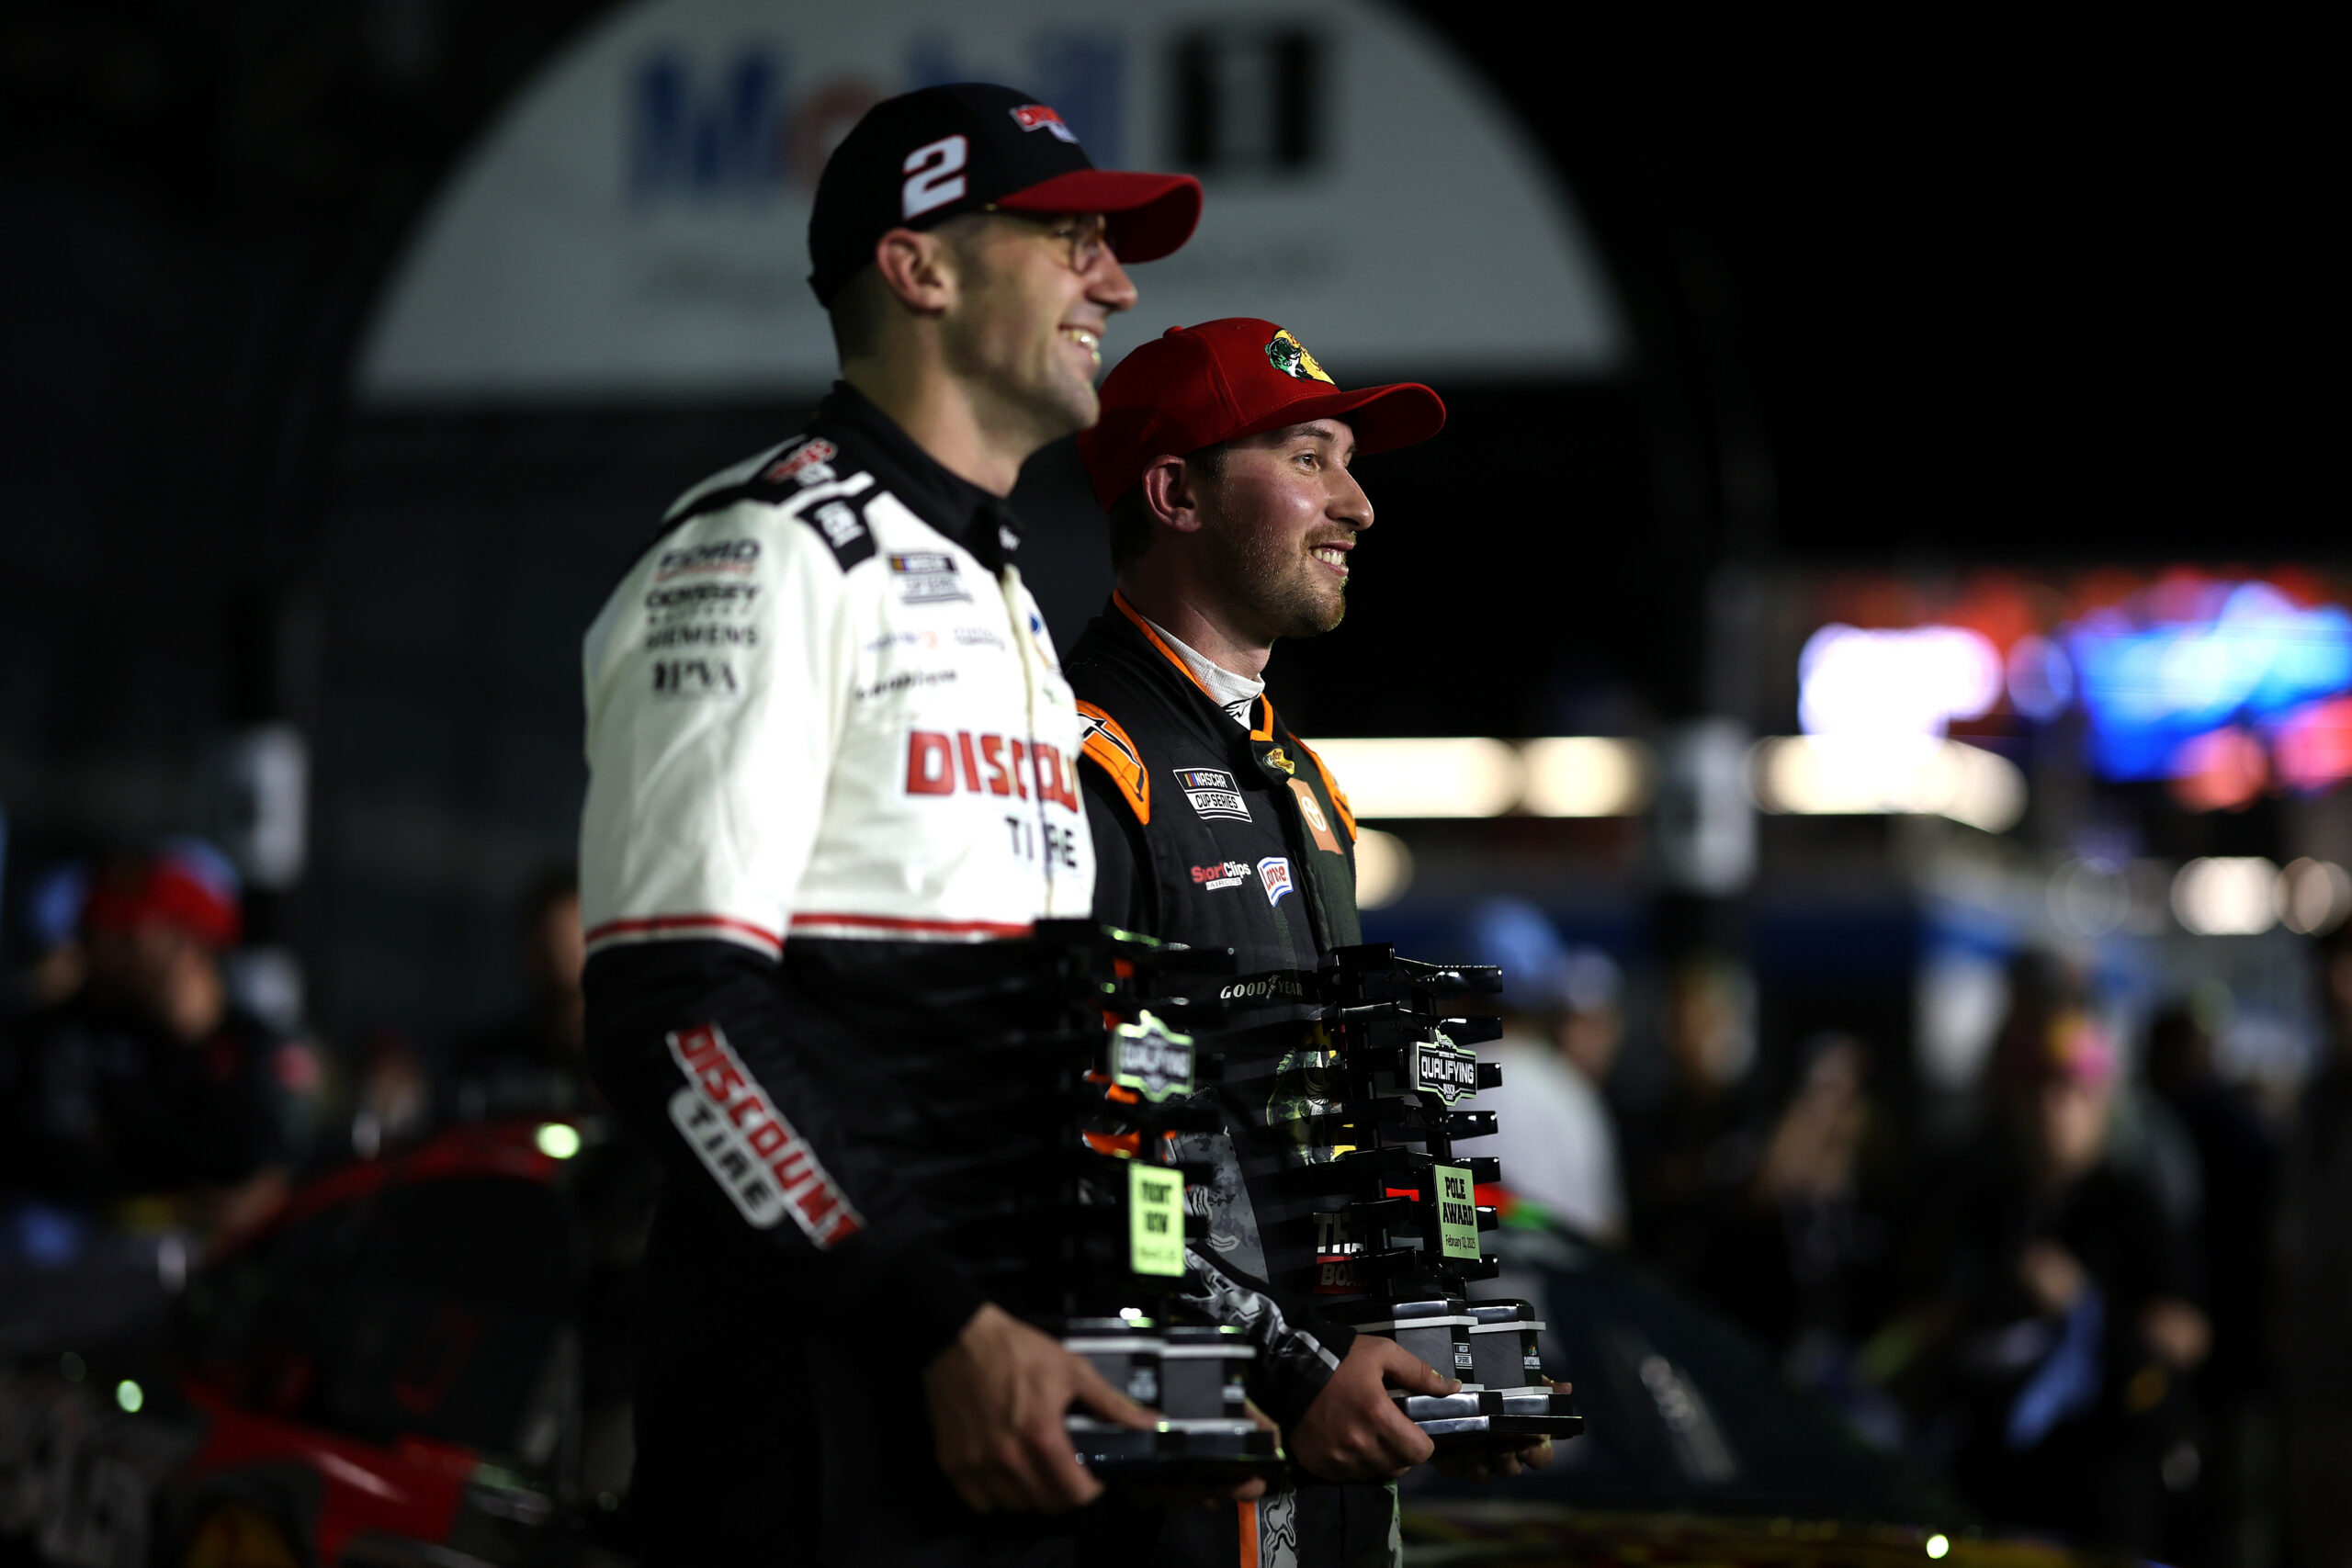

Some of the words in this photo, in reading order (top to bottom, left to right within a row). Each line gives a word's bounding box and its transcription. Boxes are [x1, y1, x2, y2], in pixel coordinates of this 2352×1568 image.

[900, 133, 969, 222] 2
[1194, 772, 1227, 788] NASCAR
[1195, 794, 1211, 808] CUP
[1212, 794, 1238, 809] SERIES
[1420, 1055, 1475, 1084] QUALIFYING
[688, 1102, 774, 1213] TIRE
[1444, 1176, 1466, 1200] POLE
[1442, 1201, 1474, 1226] AWARD
